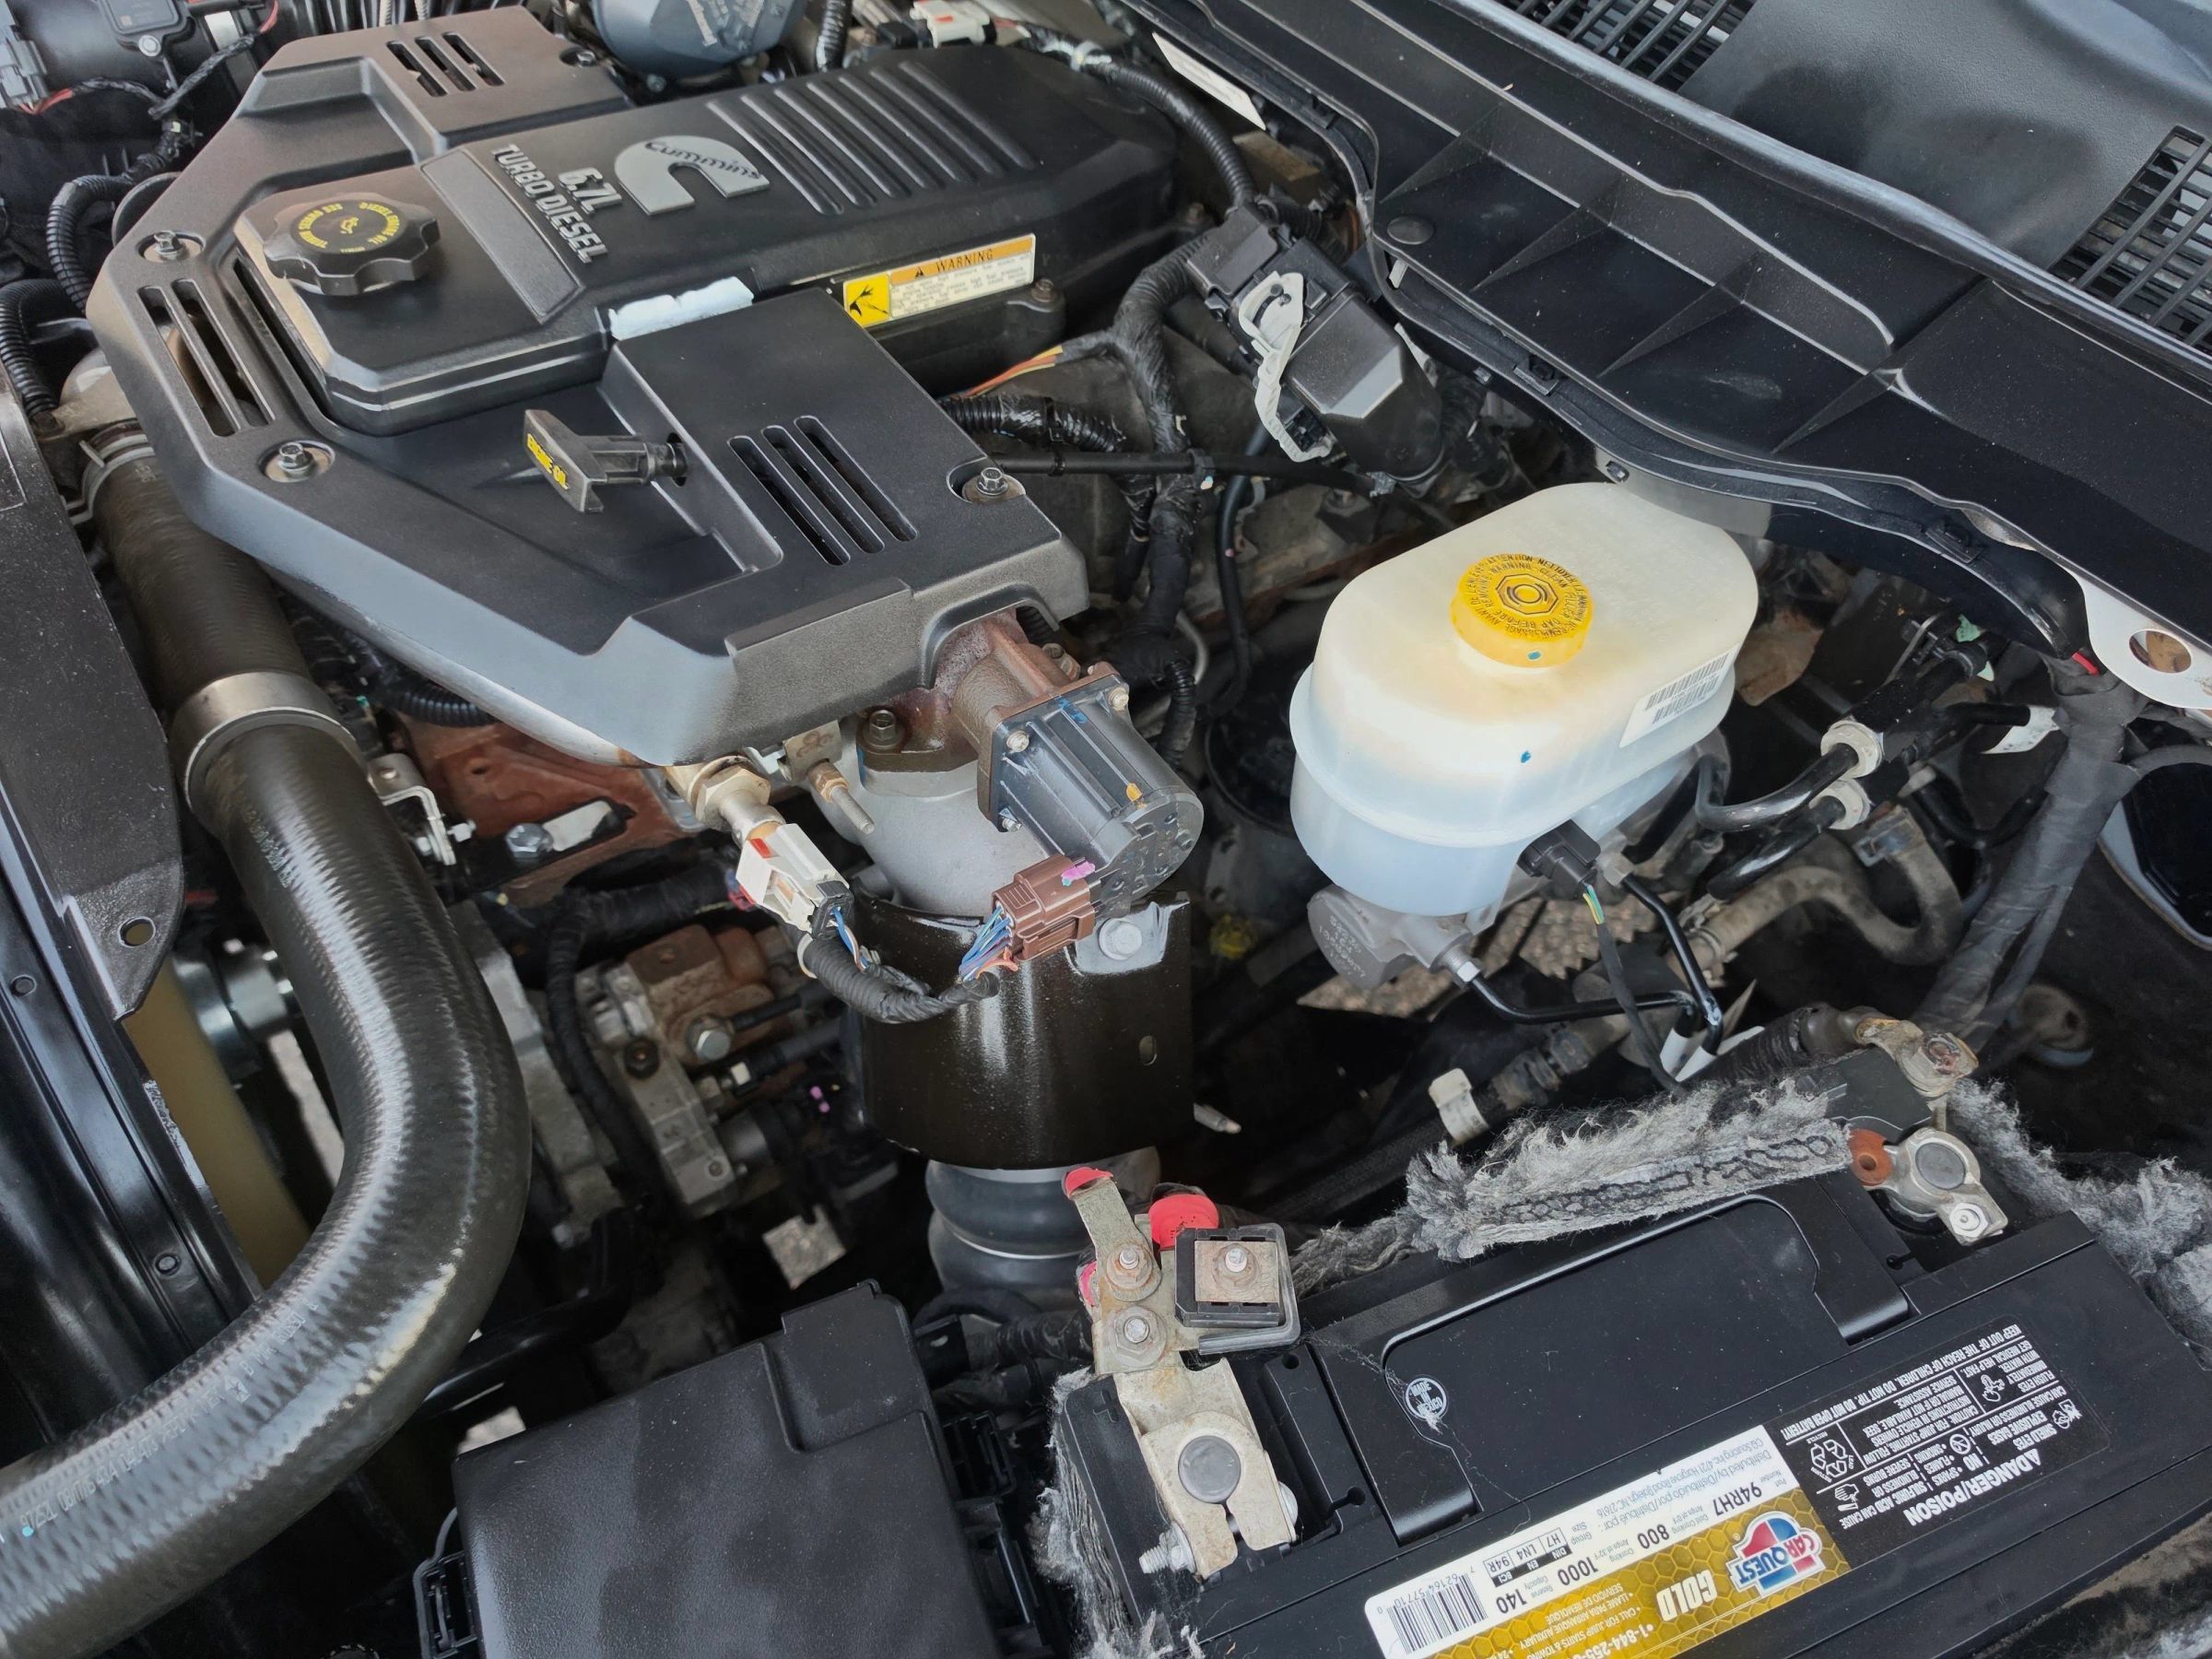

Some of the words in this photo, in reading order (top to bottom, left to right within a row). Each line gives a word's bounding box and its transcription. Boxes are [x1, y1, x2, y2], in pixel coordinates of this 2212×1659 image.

[645, 140, 762, 180] Cummins
[558, 167, 623, 216] 6.7L
[491, 144, 555, 198] TURBO
[535, 194, 608, 264] DIESEL
[935, 249, 994, 274] WARNING
[1984, 1331, 2005, 1346] OUT
[2000, 1324, 2022, 1339] KEEP
[1961, 1342, 1980, 1357] THE
[1975, 1337, 1991, 1350] OF
[2016, 1339, 2032, 1352] GET
[1939, 1348, 1967, 1367] REACH
[1991, 1345, 2020, 1363] MEDICAL
[2019, 1349, 2040, 1363] WITH
[1928, 1359, 1944, 1371] OF
[1959, 1363, 1981, 1378] FAST.
[1976, 1356, 1995, 1371] HELP
[1997, 1356, 2024, 1373] WATER.
[2004, 1359, 2047, 1384] IMMEDIATELY
[1929, 1374, 1957, 1393] SERVICE
[2017, 1378, 2036, 1393] EYES
[2031, 1369, 2055, 1385] FLUSH
[1866, 1384, 1886, 1400] NOT
[1881, 1380, 1897, 1394] DO
[1936, 1384, 1964, 1403] MANUAL
[2049, 1384, 2067, 1398] CAN
[1841, 1398, 1857, 1412] DO
[1923, 1399, 1932, 1409] IF
[1926, 1394, 1971, 1420] INSTRUCTIONS
[1927, 1394, 1941, 1406] OR
[2030, 1390, 2054, 1407] CAUSE
[1811, 1408, 1833, 1426] OPEN
[1829, 1403, 1847, 1418] NOT
[1909, 1402, 1926, 1416] NOT
[1947, 1404, 1979, 1425] CAUTION:
[1998, 1399, 2035, 1422] BLINDNESS
[1895, 1416, 1924, 1435] VEHICLE
[1919, 1413, 1931, 1424] IN
[1933, 1418, 1950, 1431] FOR
[1989, 1414, 2004, 1427] OR
[2006, 1408, 2047, 1435] EXPLOSIVE
[1779, 1417, 1816, 1441] BATTERY!
[1862, 1422, 1881, 1438] SEEK
[1916, 1423, 1937, 1439] JUMP
[1967, 1418, 1994, 1437] INJURY
[1985, 1425, 2014, 1445] GASES
[2028, 1422, 2057, 1442] SHIELD
[1806, 1430, 1828, 1444] RECYCLE
[2011, 1432, 2035, 1451] EYES
[1722, 1441, 1752, 1461] Sourcing
[1862, 1445, 1890, 1465] FOLLOW
[1912, 1442, 1944, 1464] SMOKING
[1697, 1459, 1713, 1472] 4721
[1726, 1449, 1771, 1475] Distributed
[1884, 1456, 1911, 1476] SEVERE
[1922, 1454, 1951, 1475] FLAMES
[1960, 1452, 1983, 1472] NO
[1666, 1464, 1700, 1485] Hargrove
[1670, 1466, 1730, 1500] by/Distribuido
[1758, 1469, 1782, 1484] Number
[1862, 1468, 1888, 1486] BURNS
[1881, 1468, 1919, 1493] BLINDNESS
[1930, 1465, 1959, 1487] SPARKS
[1651, 1477, 1672, 1493] Road
[1870, 1485, 1885, 1498] OR
[1890, 1479, 1927, 1505] SULFURIC
[1901, 1452, 2034, 1528] DANGER/POISON
[1614, 1497, 1630, 1510] NC
[1708, 1480, 1764, 1516] 94RH7
[1873, 1495, 1895, 1513] ACID
[1595, 1502, 1618, 1519] 27616
[1616, 1490, 1675, 1524] por/Distribué
[1687, 1504, 1704, 1516] Amps
[1859, 1503, 1877, 1519] CAN
[1571, 1521, 1587, 1533] Size
[1670, 1518, 1696, 1535] Cranking
[1694, 1513, 1709, 1524] Cold
[1838, 1510, 1864, 1529] CAUSE
[1543, 1533, 1560, 1547] H7
[1569, 1530, 1593, 1547] Group
[1611, 1537, 1630, 1550] Amps
[1634, 1523, 1671, 1550] 800
[1514, 1543, 1536, 1560] LN4
[1550, 1547, 1567, 1559] DIN
[1607, 1546, 1634, 1563] Cranking
[1734, 1533, 1815, 1584] CARQUEST
[1468, 1565, 1475, 1573] 7
[1487, 1555, 1511, 1572] 94R
[1525, 1559, 1539, 1570] EN
[1555, 1556, 1598, 1586] 1000
[1426, 1572, 1459, 1594] 62164
[1497, 1570, 1513, 1583] BCI
[1523, 1573, 1548, 1591] Capacity
[1393, 1587, 1425, 1608] 57710
[1529, 1583, 1553, 1599] Reserve
[1591, 1582, 1624, 1602] SERVICIO
[1654, 1568, 1717, 1623] GOLD
[1493, 1587, 1527, 1615] 140
[1581, 1595, 1594, 1607] DE
[1604, 1592, 1629, 1608] LLAME
[1376, 1606, 1383, 1614] 0
[1544, 1601, 1583, 1624] REMOLQUE
[1587, 1602, 1607, 1617] PARA
[1618, 1606, 1637, 1620] CALL
[1551, 1610, 1591, 1633] ARRANQUE
[1583, 1620, 1606, 1636] JUMP
[1604, 1614, 1619, 1627] FOR
[1518, 1627, 1555, 1649] AUXILIARY
[1552, 1641, 1561, 1651] &
[1559, 1630, 1586, 1648] STARTS
